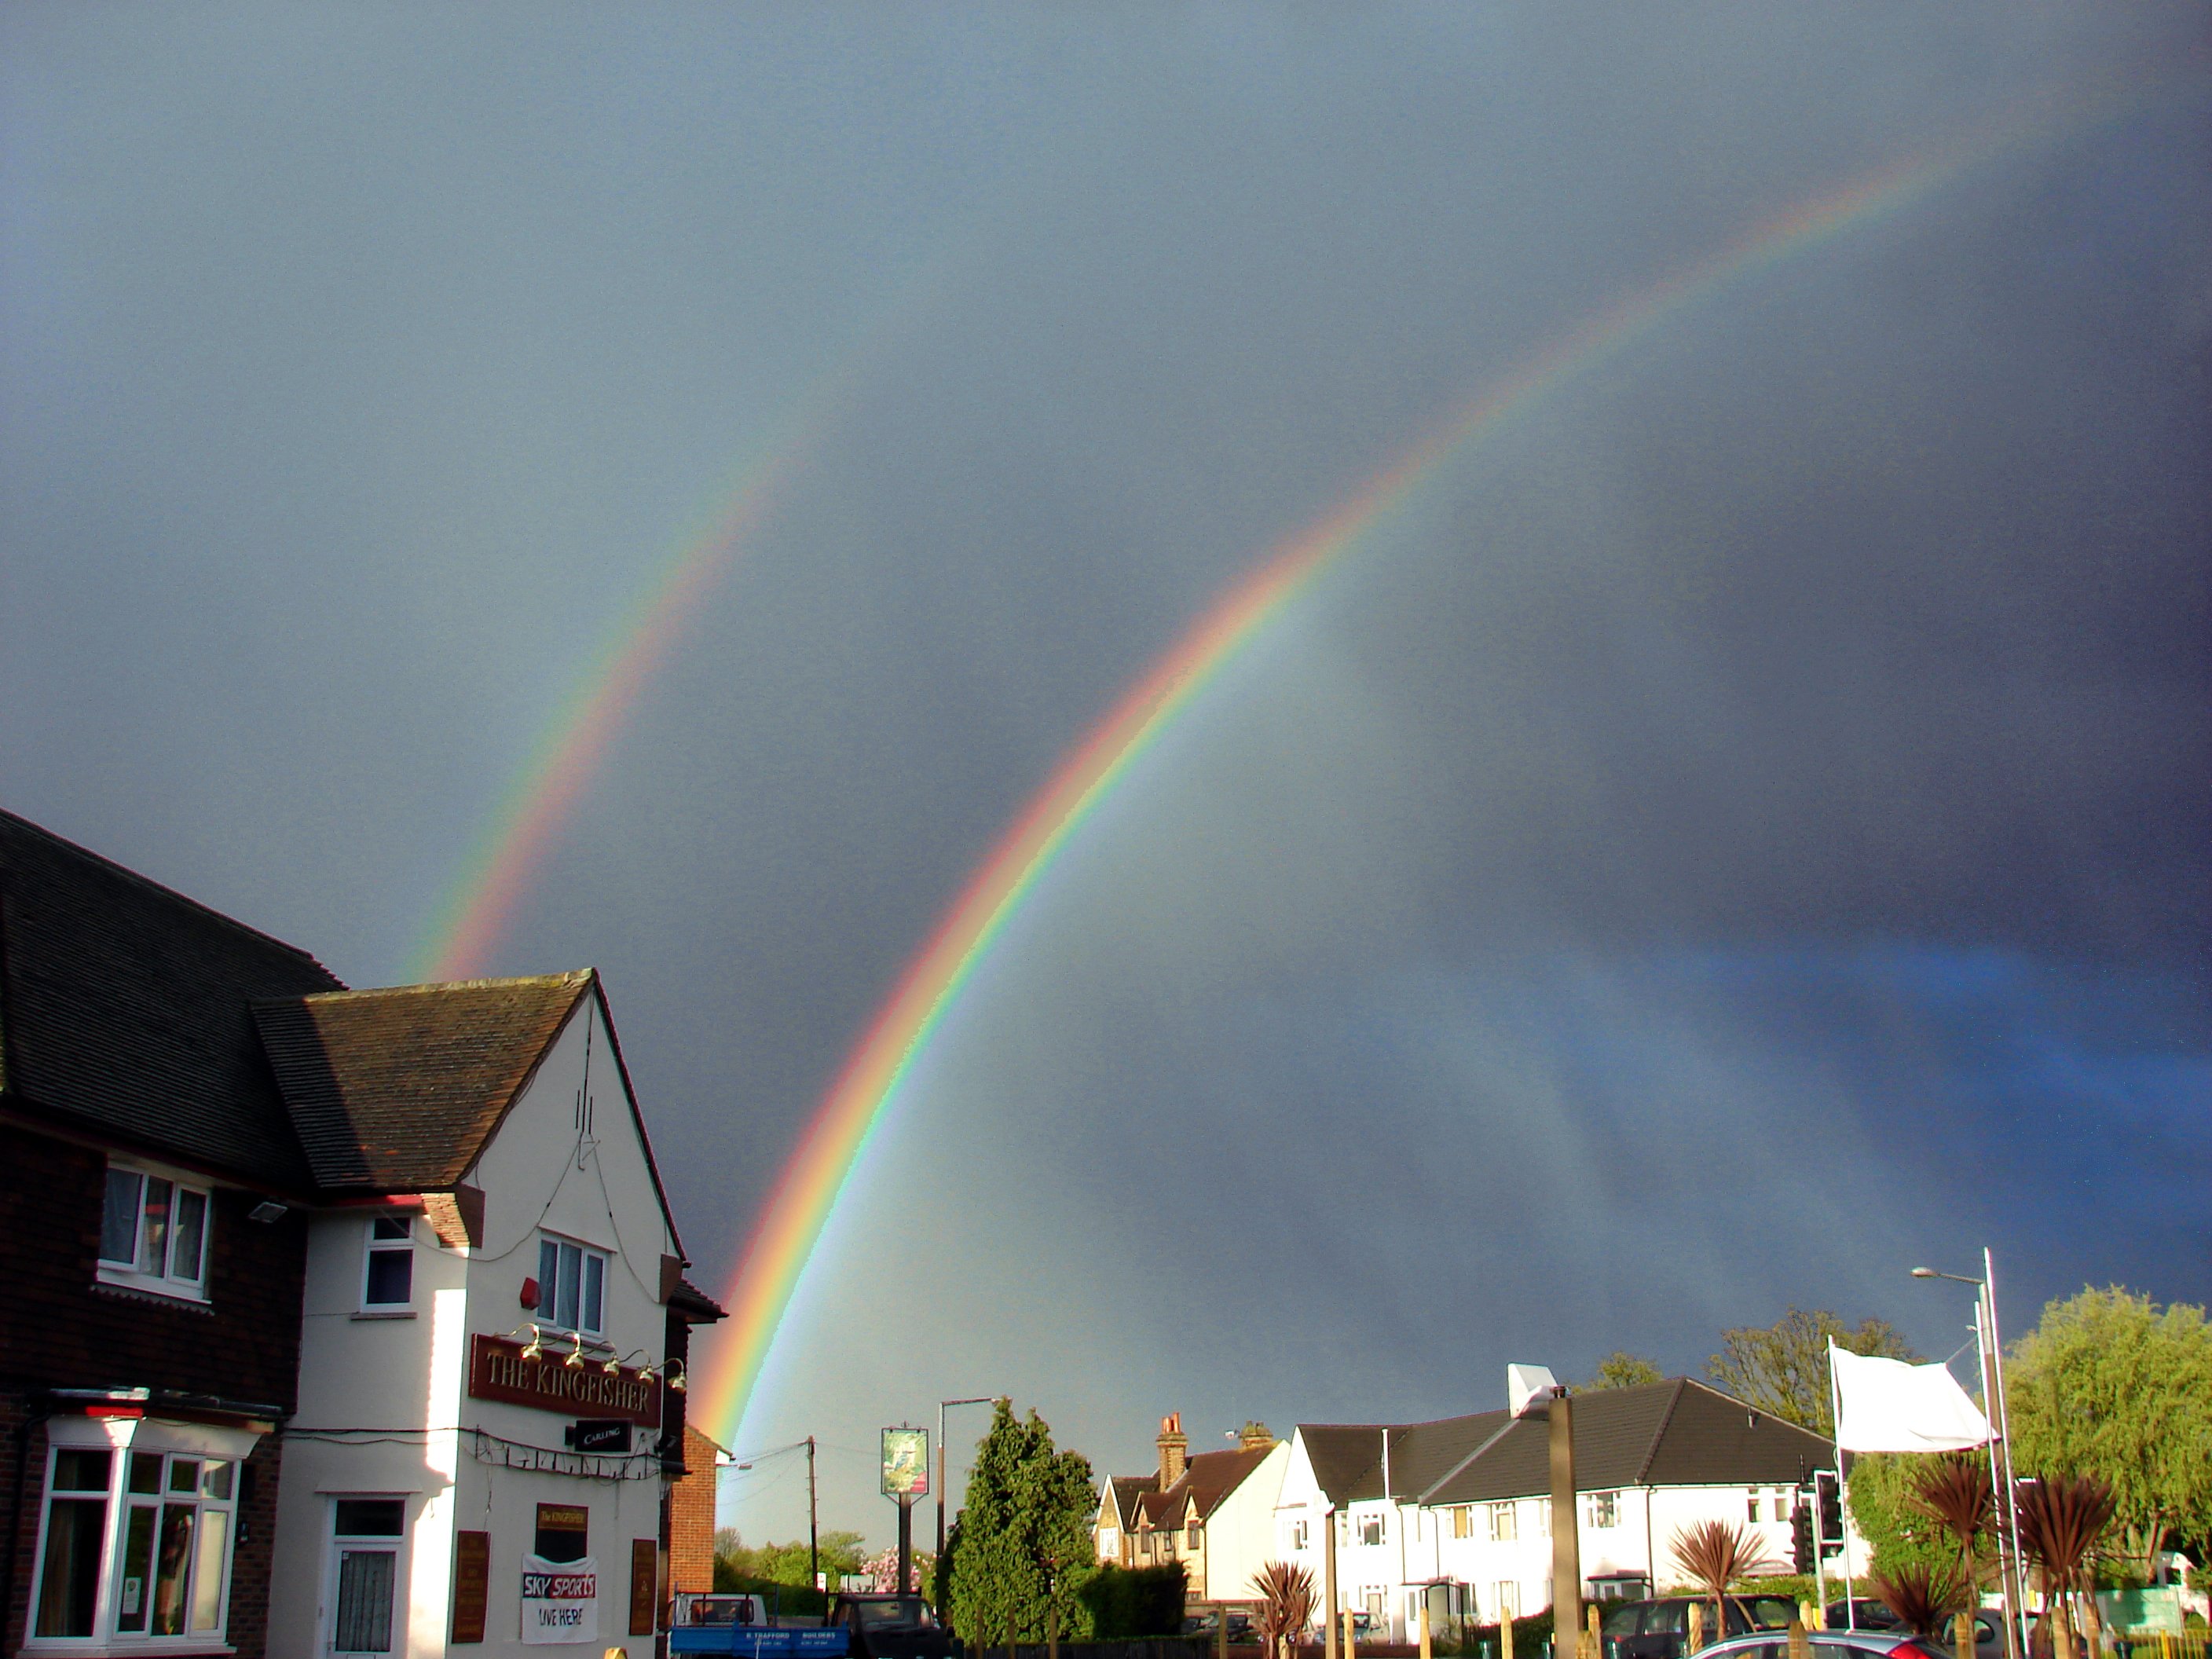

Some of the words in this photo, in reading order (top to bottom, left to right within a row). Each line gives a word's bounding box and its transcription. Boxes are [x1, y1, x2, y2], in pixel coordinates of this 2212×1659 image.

[486, 1351, 529, 1390] THE
[536, 1364, 649, 1413] KINGFISHER
[583, 1426, 621, 1446] CARLING
[524, 1575, 552, 1596] SKY
[552, 1573, 595, 1597] SPORTS
[539, 1608, 557, 1627] LIVE
[559, 1608, 583, 1626] HERE
